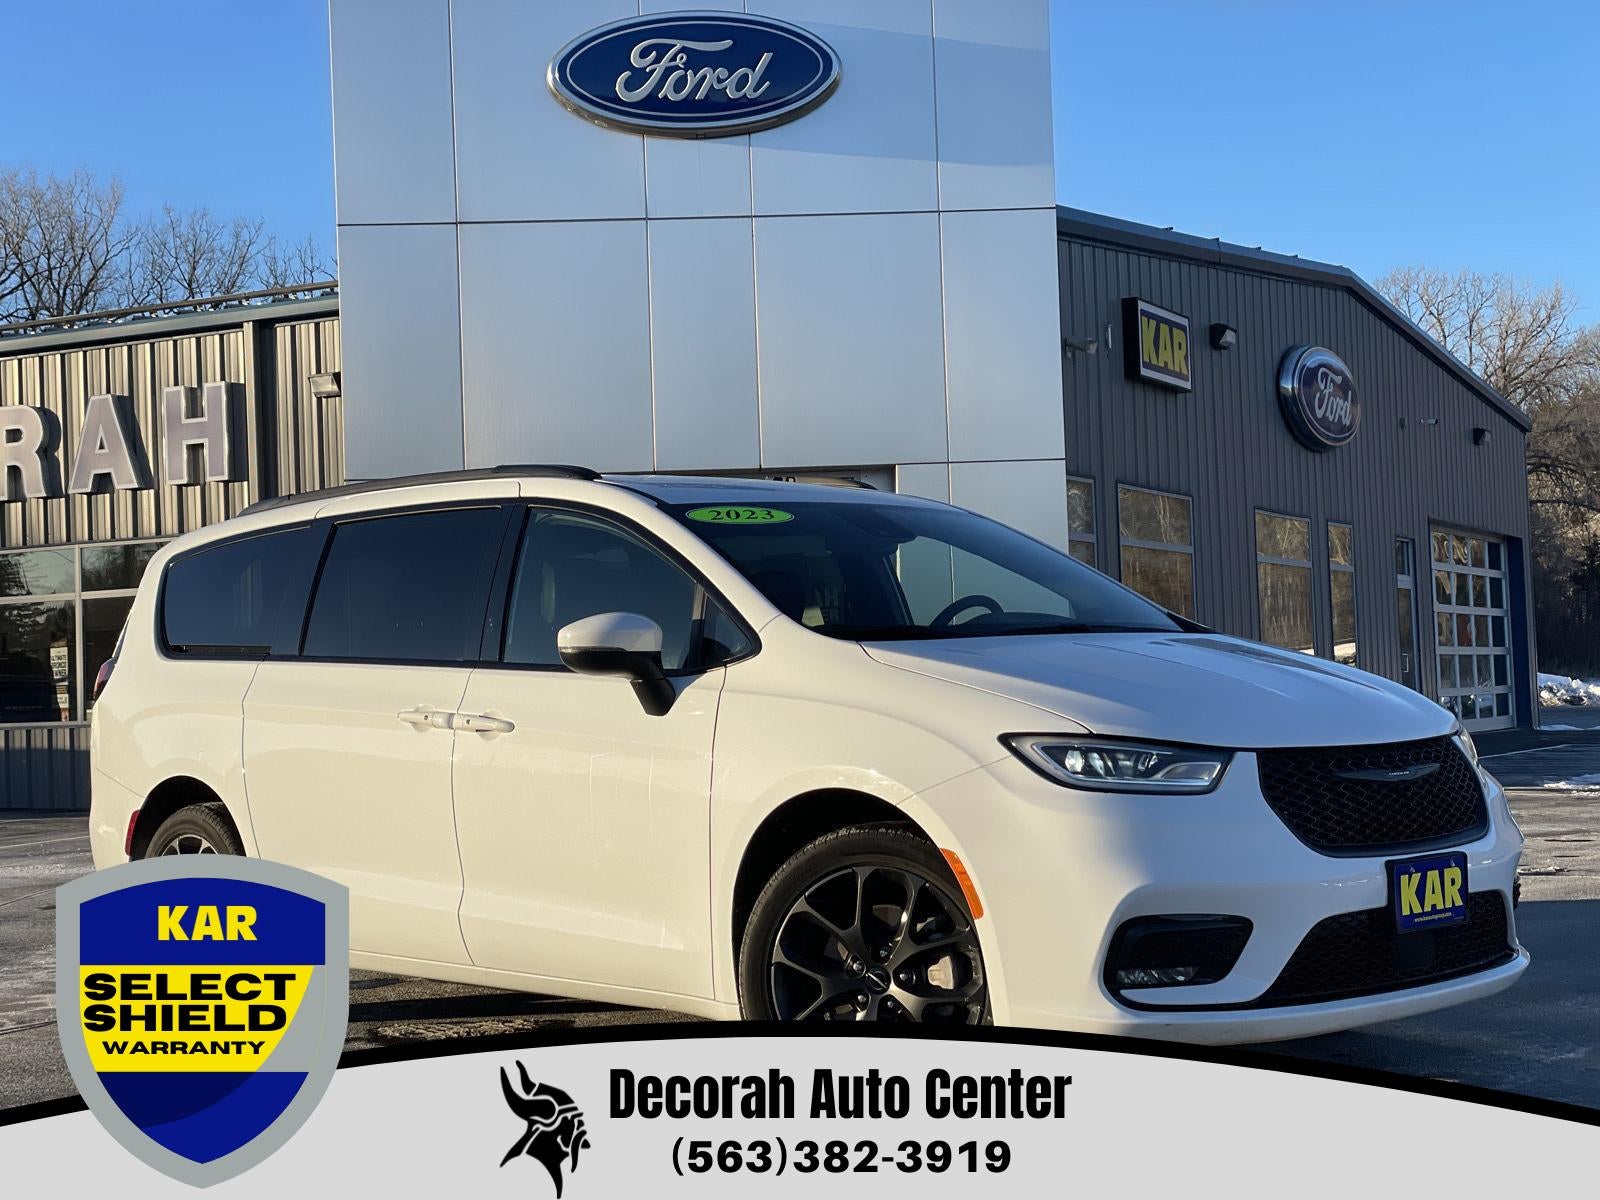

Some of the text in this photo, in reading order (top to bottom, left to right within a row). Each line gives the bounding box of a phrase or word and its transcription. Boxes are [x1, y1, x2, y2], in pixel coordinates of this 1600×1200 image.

[615, 38, 774, 102] Ford
[1141, 315, 1189, 376] KAR
[1315, 367, 1352, 426] Ford
[708, 509, 775, 520] 2023
[1400, 867, 1463, 916] KAR
